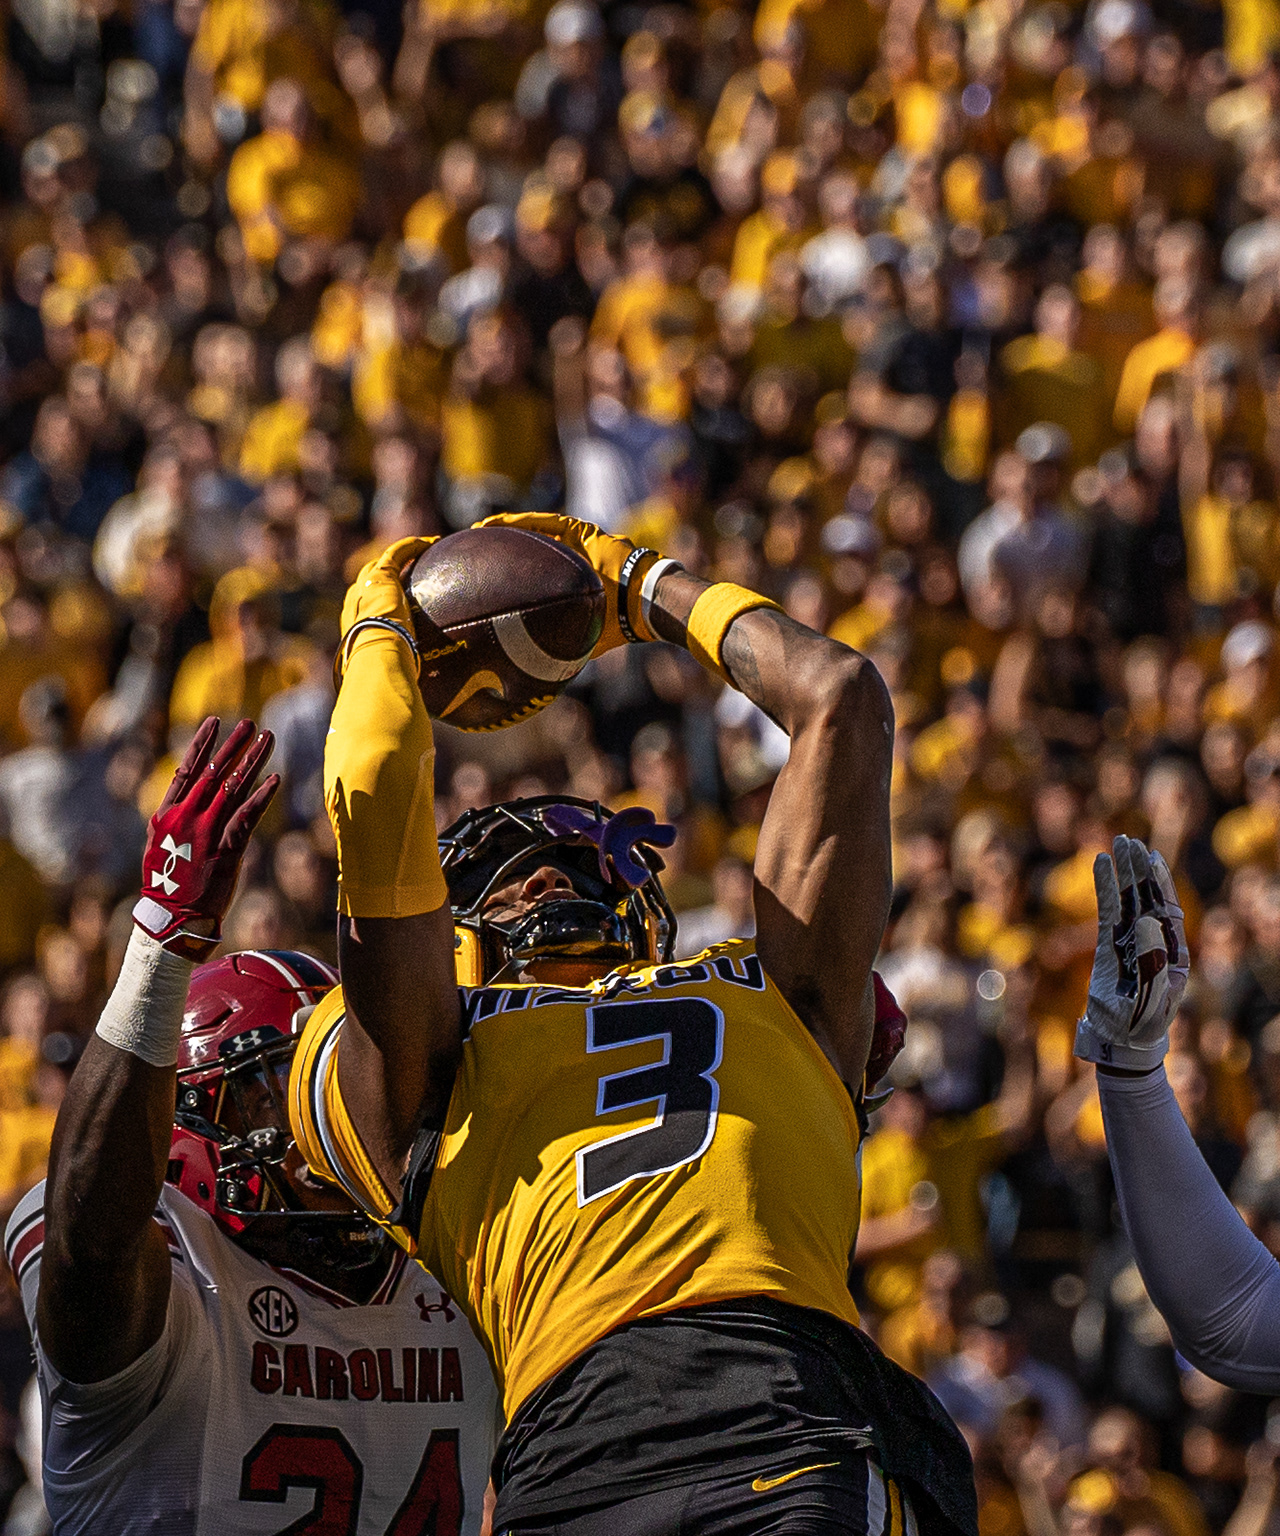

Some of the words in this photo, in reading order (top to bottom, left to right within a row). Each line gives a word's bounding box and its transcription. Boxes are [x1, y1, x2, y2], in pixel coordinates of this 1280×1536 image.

[575, 996, 726, 1209] 3
[252, 1287, 297, 1335] SEC
[250, 1341, 464, 1402] CAROLINA
